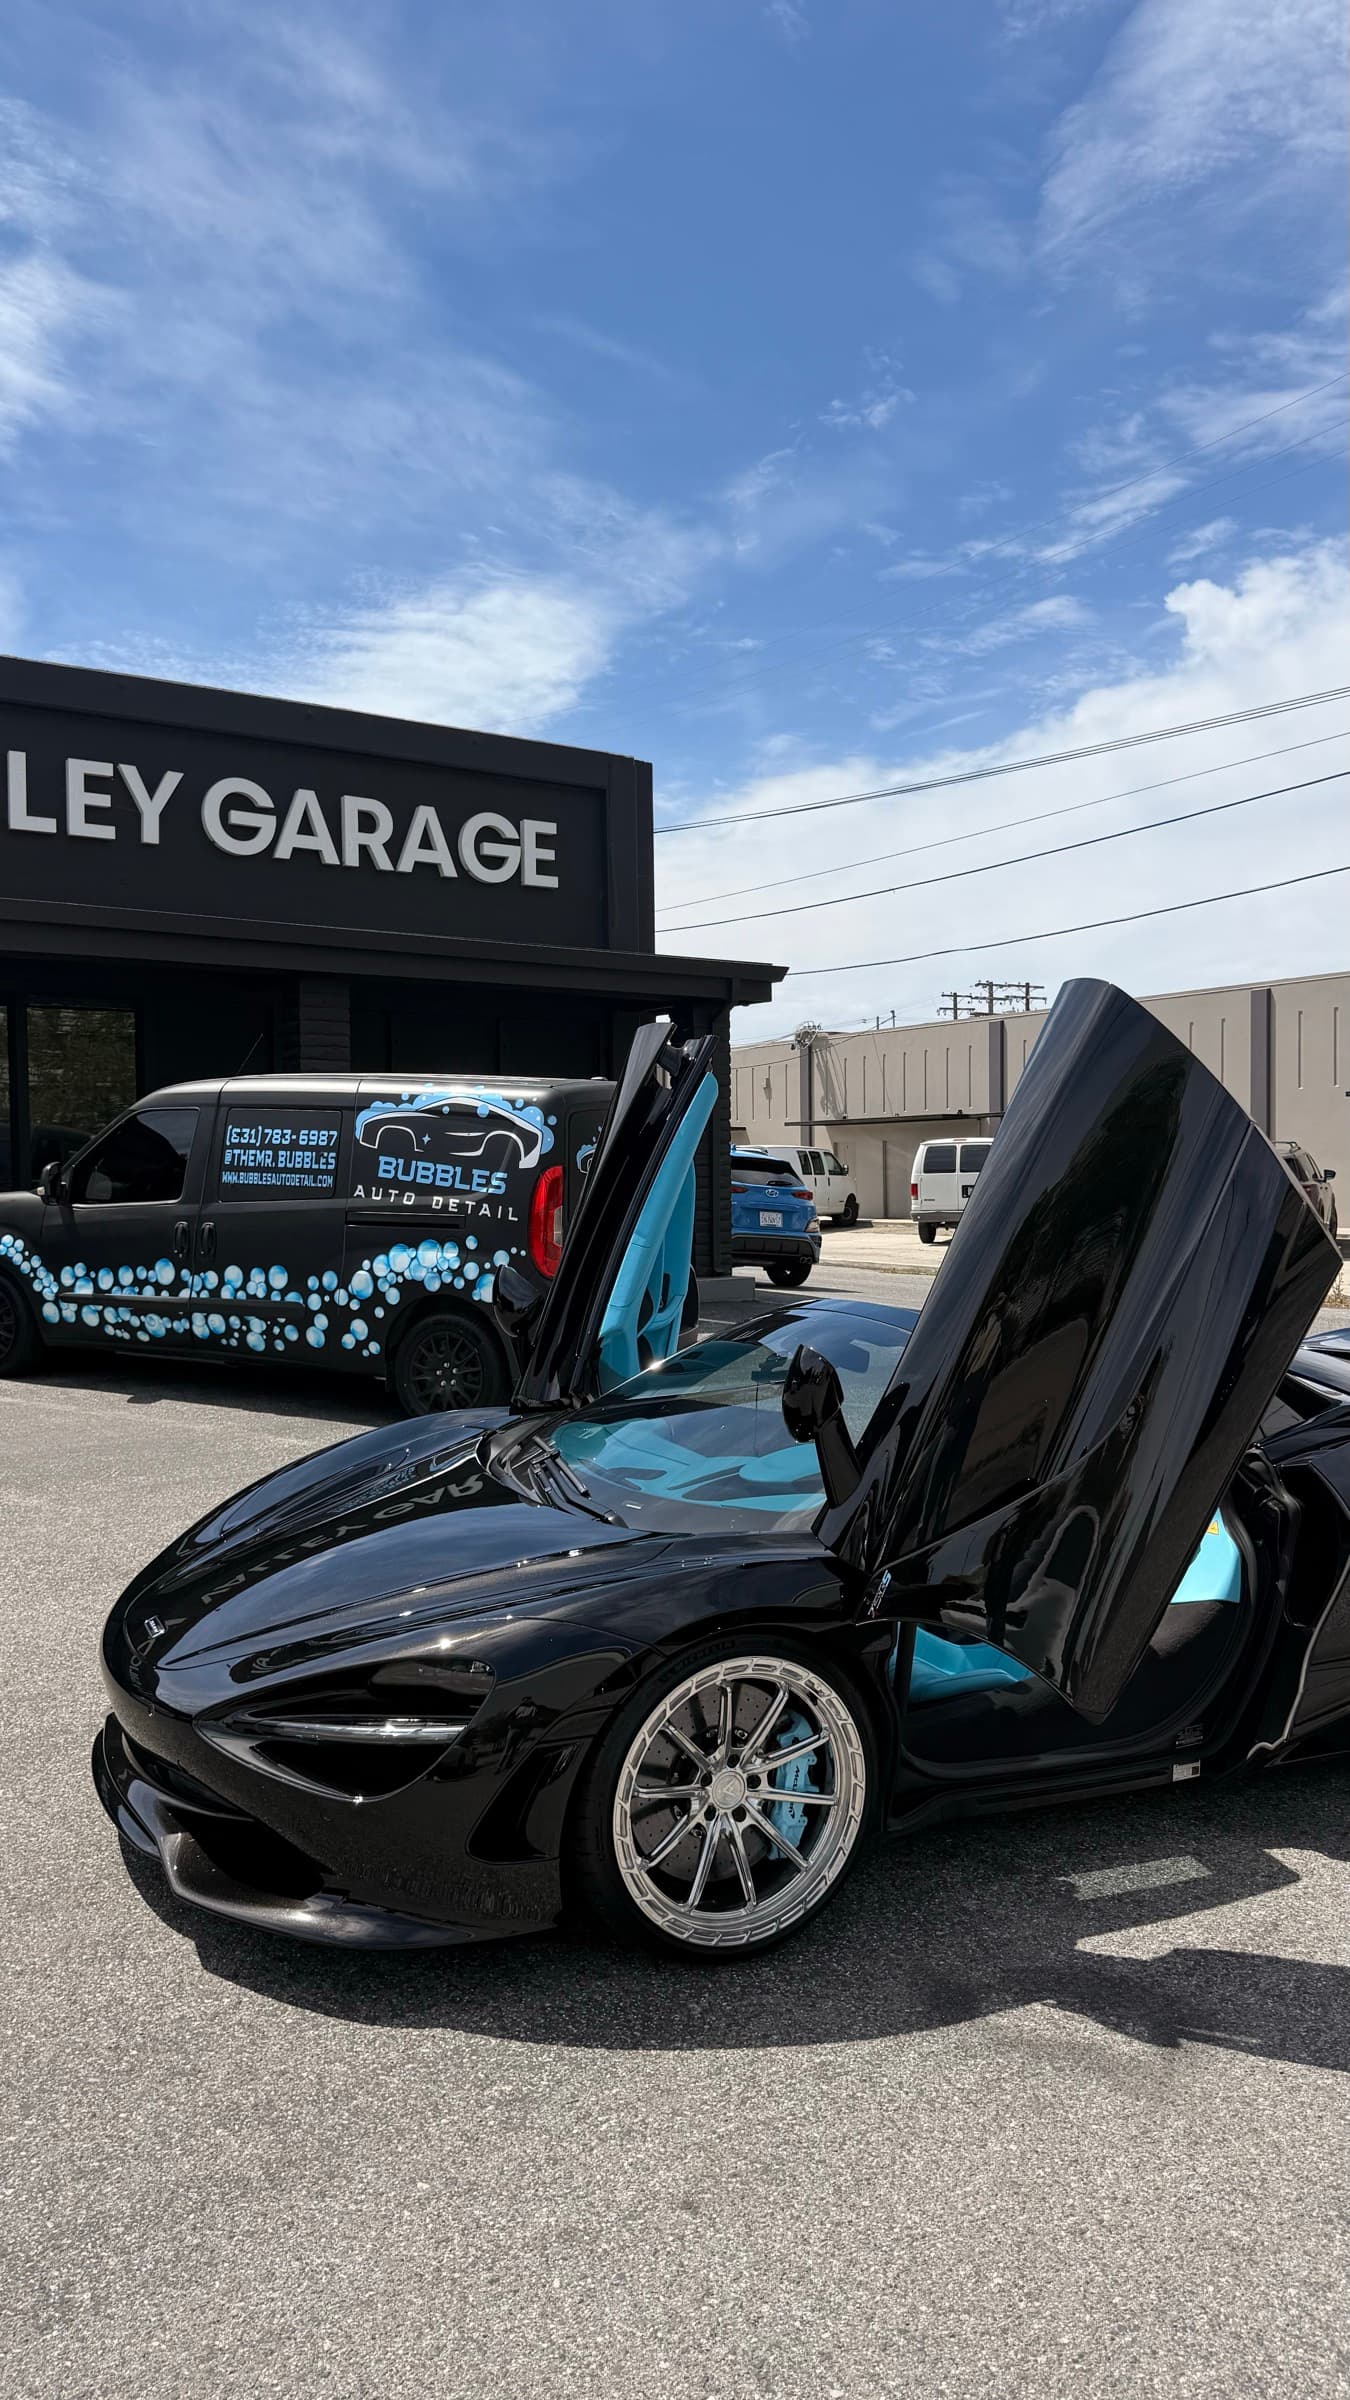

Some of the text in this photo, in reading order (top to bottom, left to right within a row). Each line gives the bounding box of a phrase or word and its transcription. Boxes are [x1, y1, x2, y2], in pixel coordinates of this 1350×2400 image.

[7, 750, 559, 888] LEY GARAGE
[222, 1171, 334, 1188] WWW.BUBBLESAUTODETAIL.COM
[377, 1156, 508, 1195] BUBBLES
[353, 1185, 519, 1221] AUTO DETAIL
